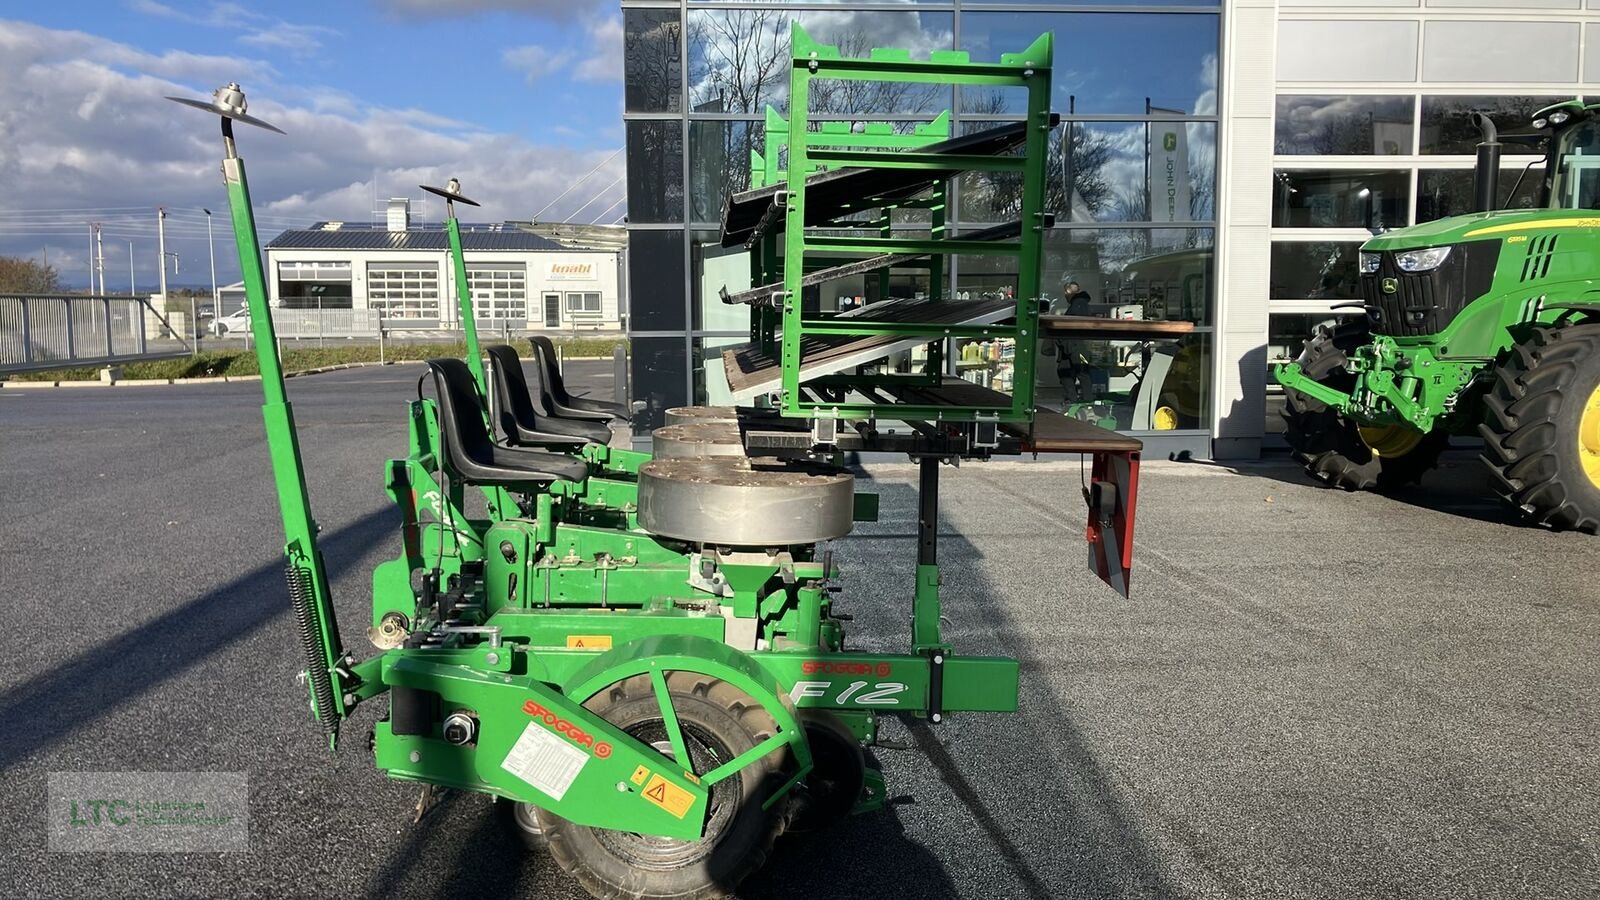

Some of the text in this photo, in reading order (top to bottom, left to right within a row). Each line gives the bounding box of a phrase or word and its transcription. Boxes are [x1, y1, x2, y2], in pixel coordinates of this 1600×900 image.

[801, 660, 872, 676] SFOGGIA
[788, 680, 909, 705] F 12
[521, 699, 594, 749] SFOGGIA
